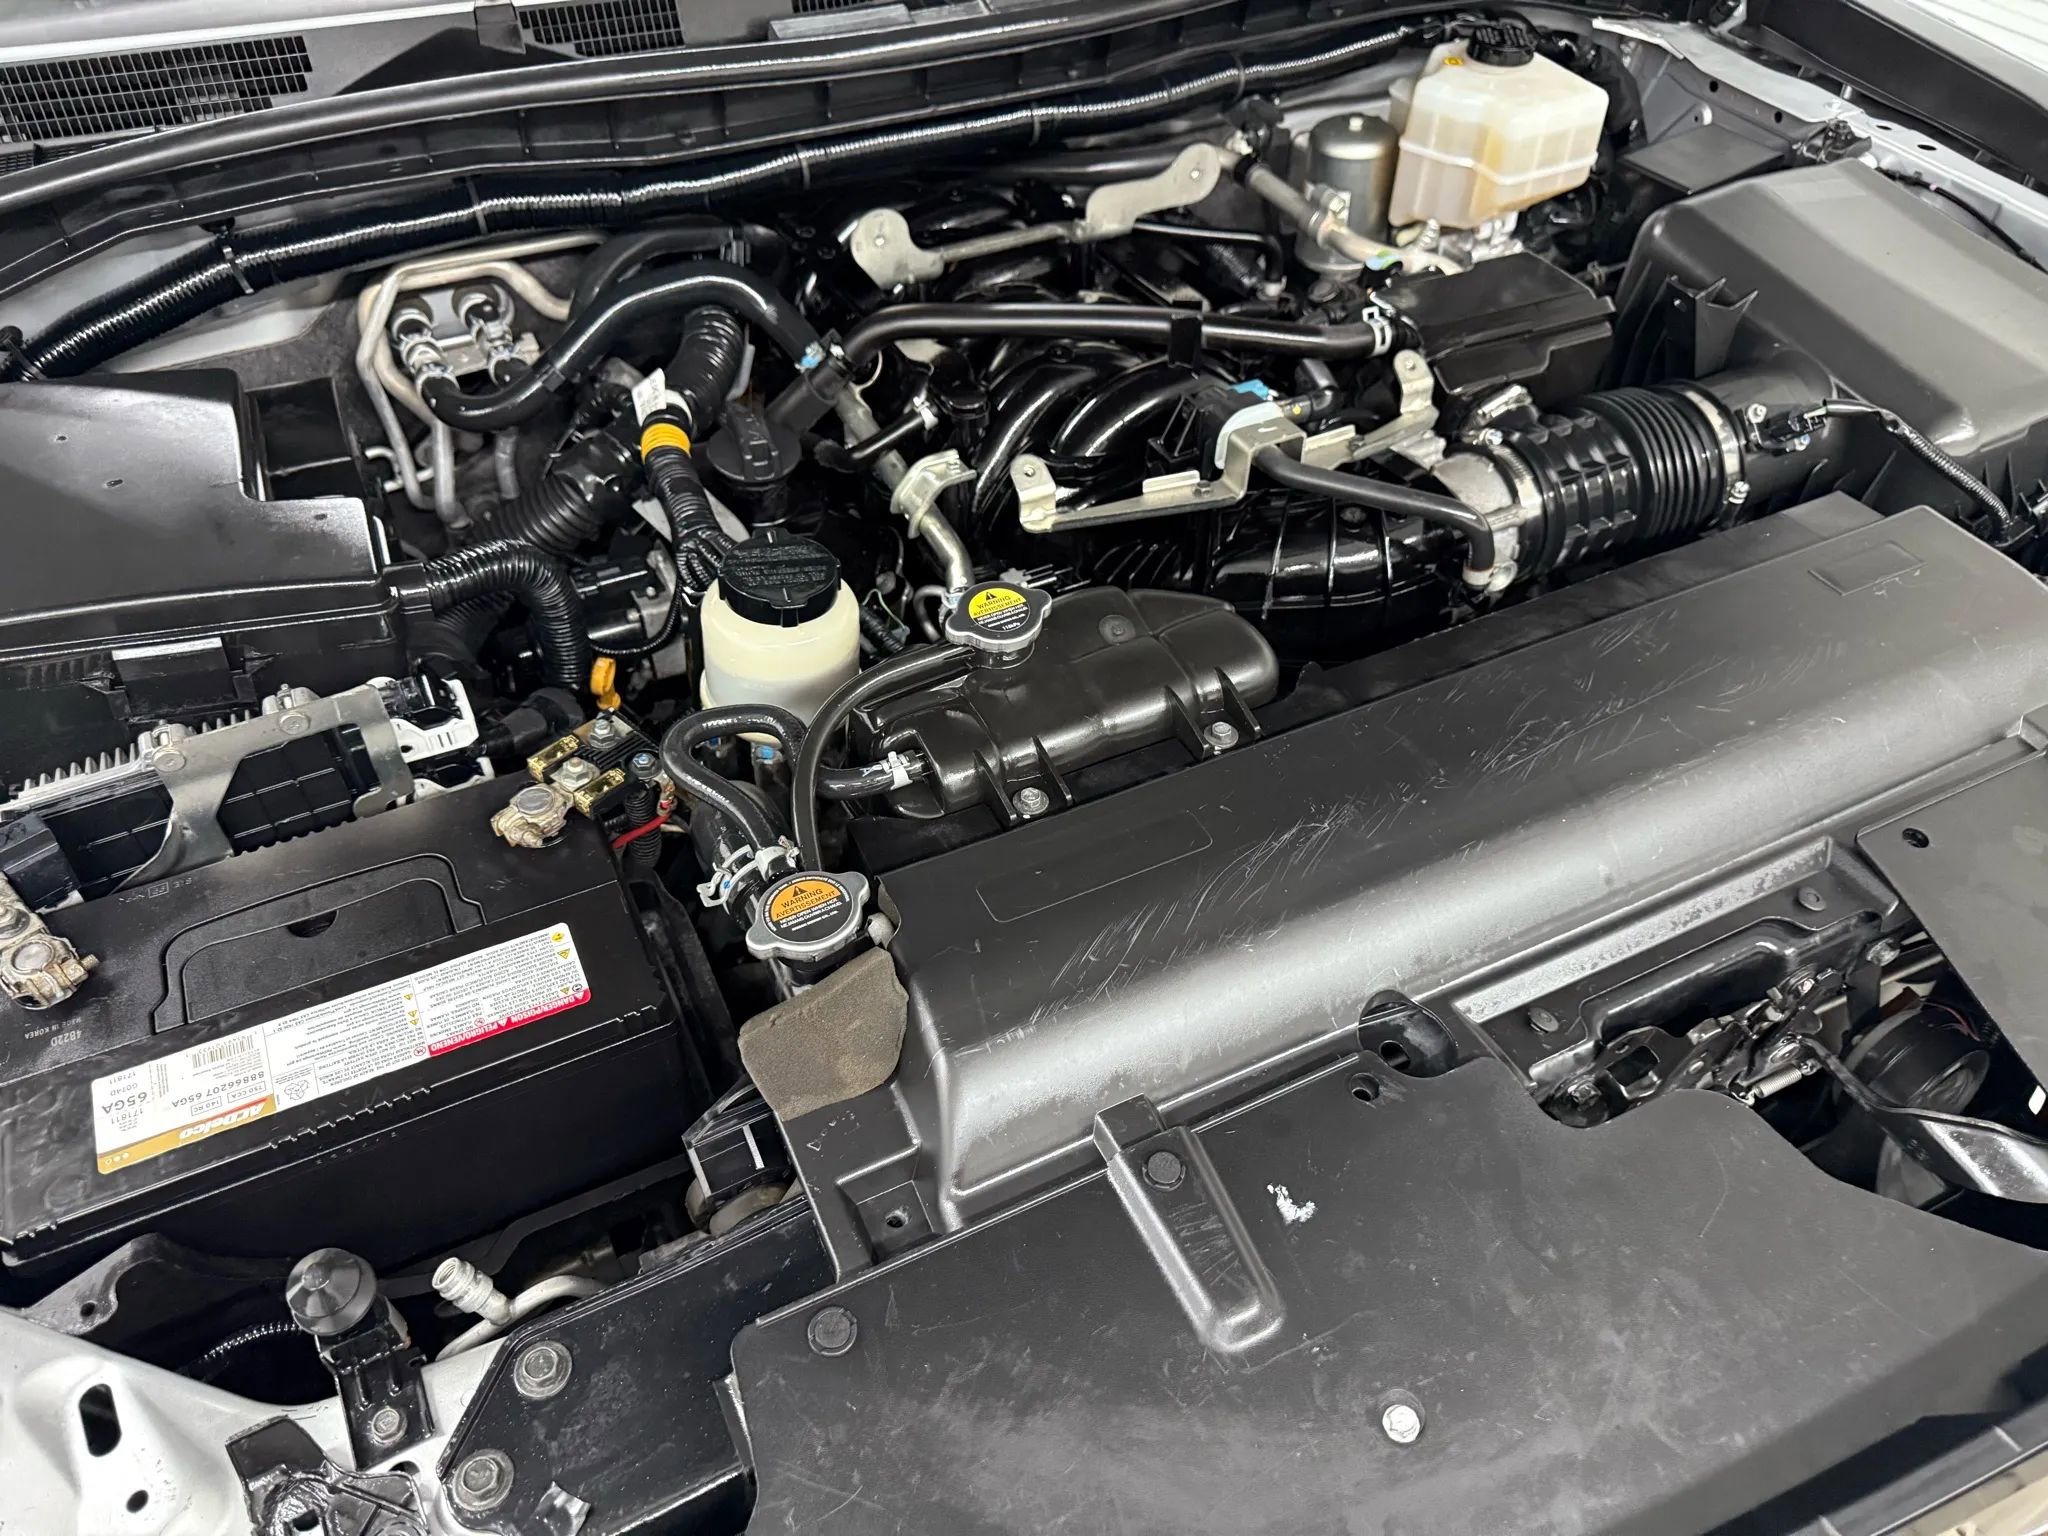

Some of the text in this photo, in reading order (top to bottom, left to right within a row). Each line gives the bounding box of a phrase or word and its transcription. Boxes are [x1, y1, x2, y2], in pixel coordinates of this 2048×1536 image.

[776, 891, 835, 918] AVERTISSEMENT
[781, 888, 823, 908] WARNING
[510, 994, 575, 1023] DANGER/POISON
[24, 1026, 50, 1039] KOREA
[429, 1021, 498, 1052] PELIGRO/VENENO
[205, 1070, 265, 1097] 88866207
[231, 1084, 262, 1100] 750 CCA
[101, 1090, 148, 1116] 65GA
[171, 1091, 202, 1109] 65GA
[193, 1099, 219, 1113] 140 RC
[110, 1107, 143, 1124] 171811
[178, 1103, 266, 1139] ACDelco
